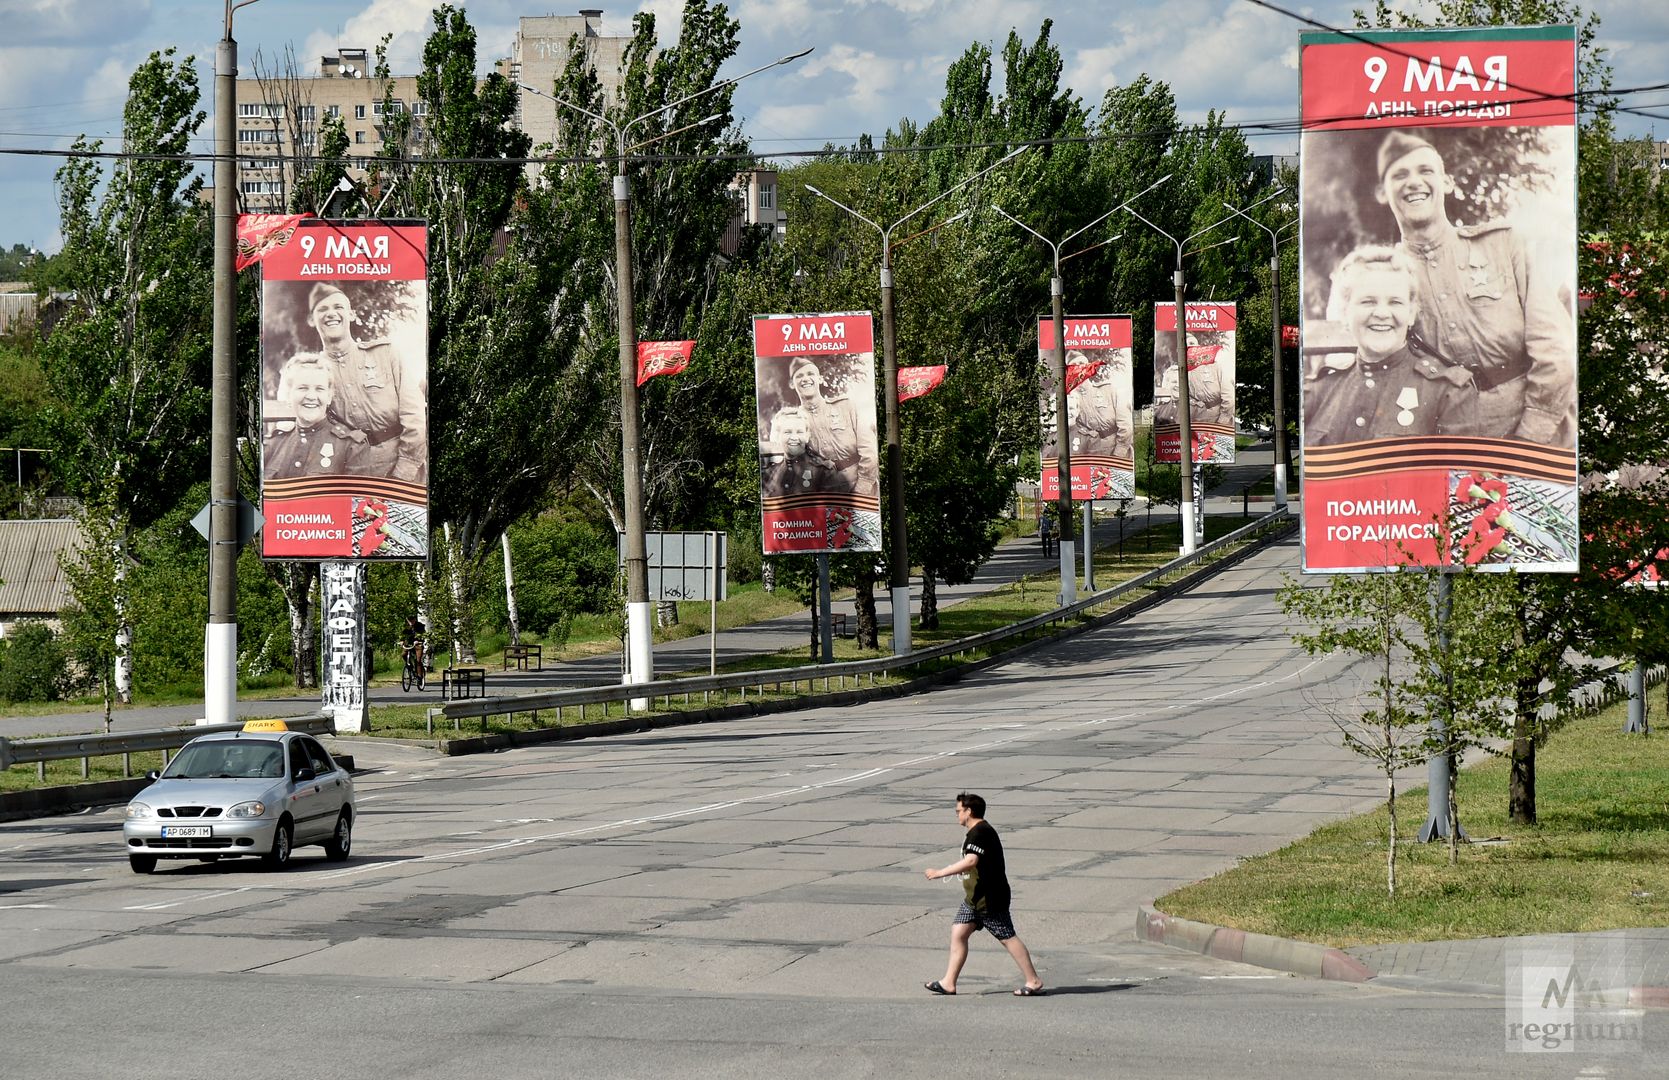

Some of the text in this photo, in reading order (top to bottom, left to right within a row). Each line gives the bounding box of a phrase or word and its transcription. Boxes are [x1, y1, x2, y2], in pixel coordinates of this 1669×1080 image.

[1364, 55, 1508, 93] 9 МАЯ
[1364, 100, 1511, 120] ДЕНЬ ПОБЕДЫ
[300, 235, 389, 258] 9 МАЯ
[300, 263, 391, 276] ДЕНЬ ПОБЕДЫ
[1185, 309, 1217, 320] МАЯ
[781, 322, 845, 341] 9 МАЯ
[1073, 324, 1110, 337] МАЯ
[782, 342, 847, 352] ДЕНЬ ПОБЕДЫ
[1327, 499, 1421, 516] ПОМНИМ,
[276, 513, 335, 525] ПОМНИМ,
[772, 520, 815, 529] ПОМНИМ,
[276, 529, 346, 541] ГОРДИМСЯ!
[773, 530, 823, 540] ГОРДИМСЯ!
[1327, 523, 1439, 542] ГОРДИМСЯ!
[328, 581, 356, 683] КАФЕЛЬ
[179, 828, 196, 836] 0689
